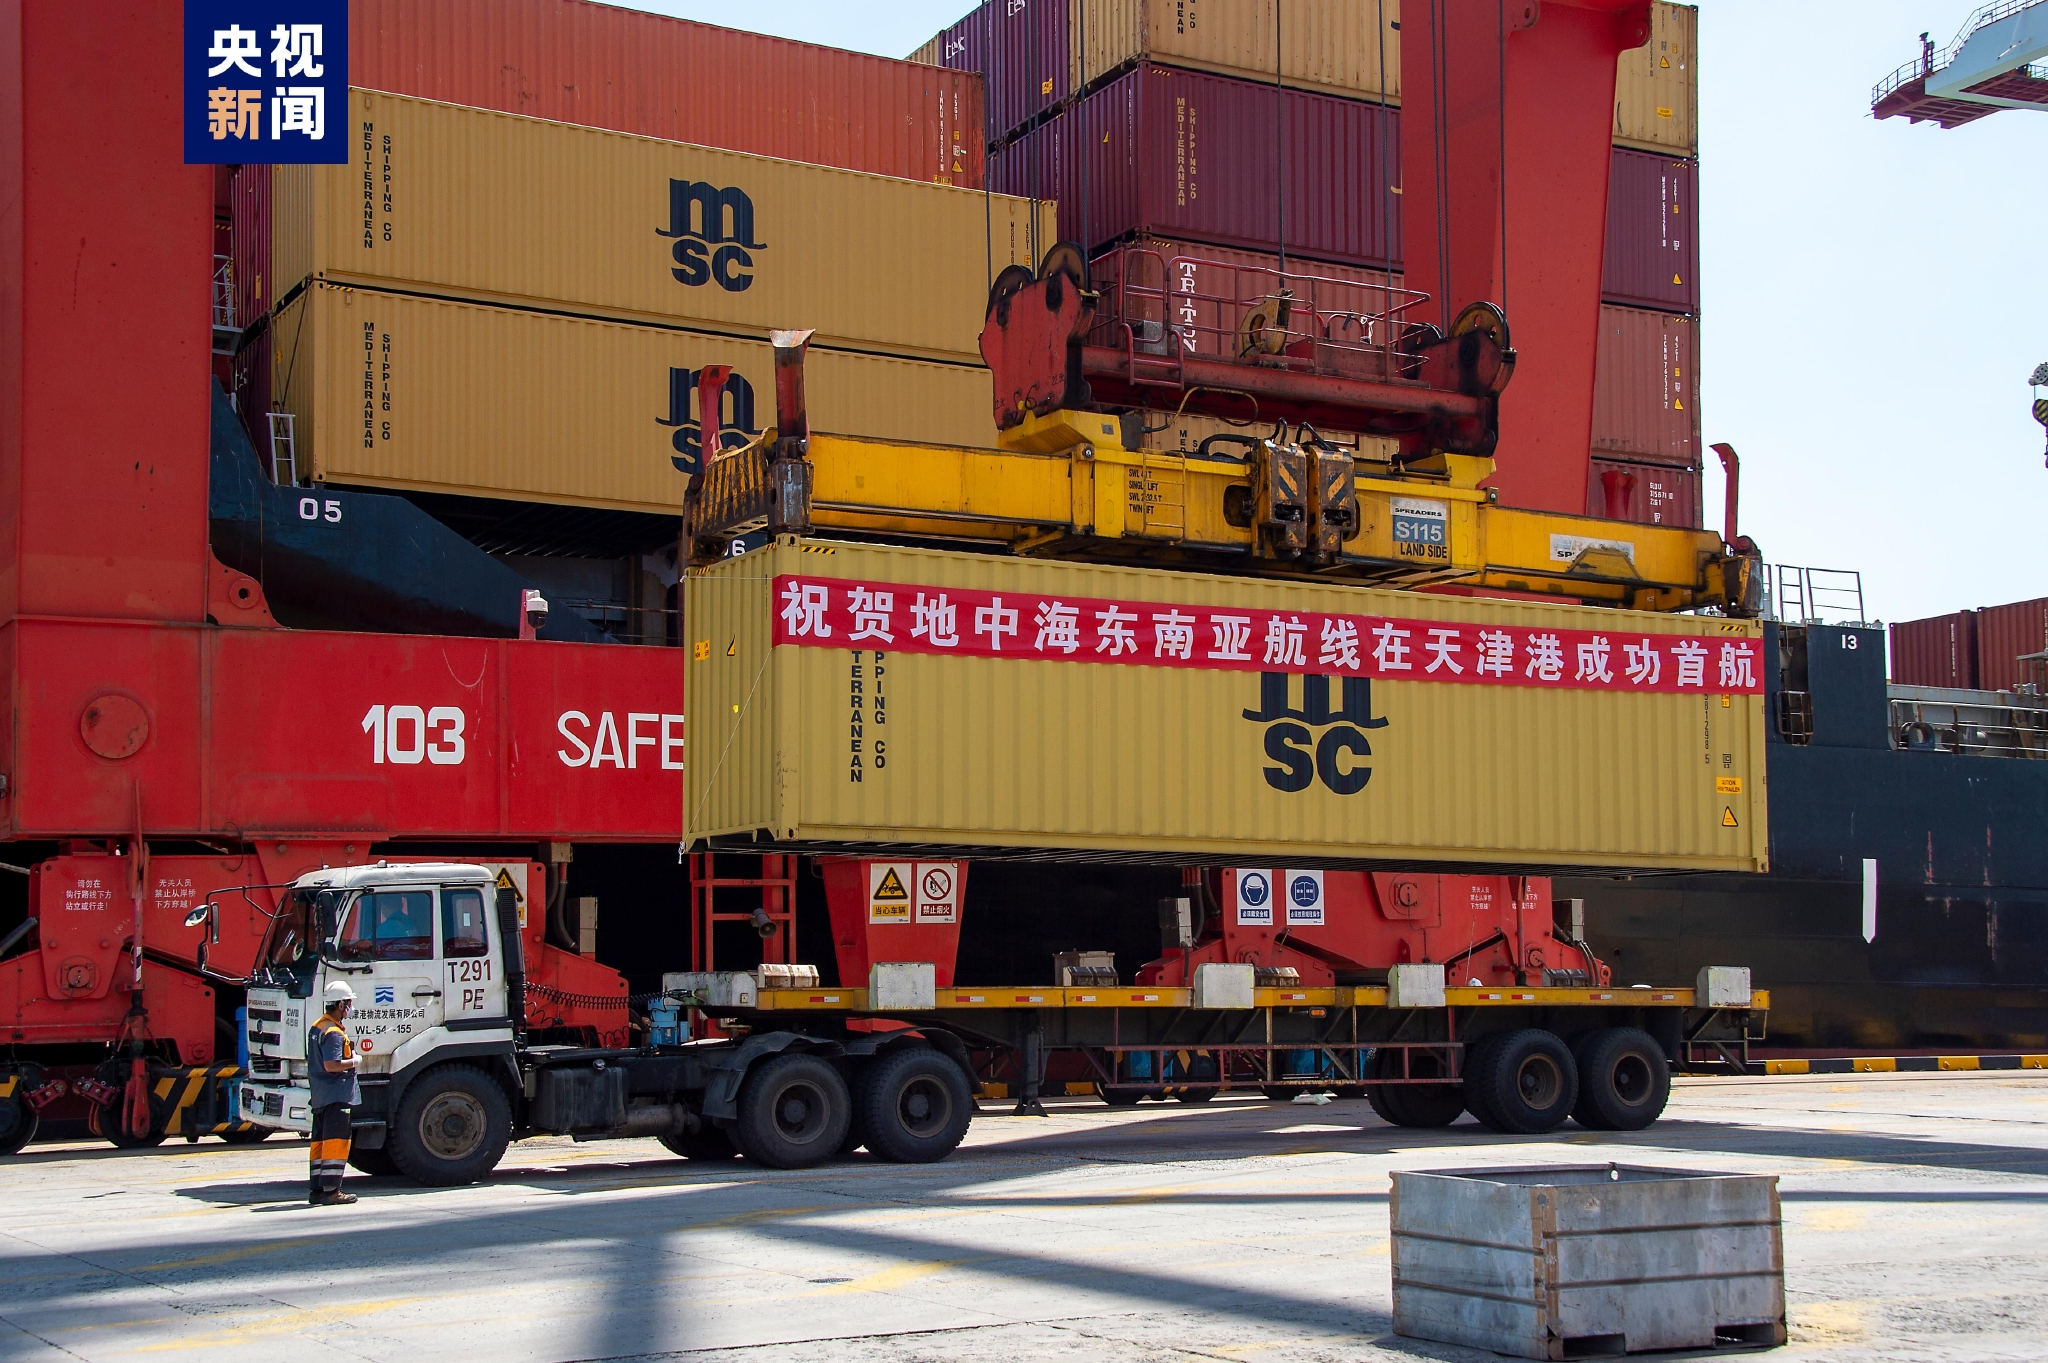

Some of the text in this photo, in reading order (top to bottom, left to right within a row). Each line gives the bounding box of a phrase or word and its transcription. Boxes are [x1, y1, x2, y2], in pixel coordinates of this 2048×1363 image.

[1177, 97, 1186, 206] MEDITERRANEAN
[1189, 108, 1197, 200] SHIPPING CO
[363, 122, 373, 249] MEDITERRANEAN
[383, 135, 392, 242] SHIPPING CO
[364, 322, 374, 449] MEDITERRANEAN
[382, 333, 391, 440] SHIPPING CO
[1129, 469, 1139, 477] SWL
[1129, 480, 1158, 491] SINGL LIFT
[1129, 492, 1139, 501] SWL
[1129, 504, 1143, 513] TWIN
[1394, 507, 1443, 517] SPREADERS
[1396, 521, 1442, 541] S115
[1400, 542, 1447, 559] LAND SIDE
[781, 580, 1757, 689] 祝贺地中海东南亚航线在天津港成功首航
[1841, 634, 1857, 650] 13
[850, 650, 863, 783] TERRANEAN
[874, 651, 886, 769] PPING CO
[361, 704, 684, 770] 103 SAFE
[77, 879, 101, 888] 请勿在
[159, 878, 192, 887] 无关人员
[65, 890, 112, 899] 钩行路线下方
[154, 889, 197, 898] 禁止从岸桥
[65, 901, 108, 911] 站立或行走！
[155, 900, 193, 909] 下方穿越！
[875, 906, 906, 915] 当心车辆
[922, 905, 950, 915] 禁止烟火
[447, 959, 491, 983] T291
[462, 988, 485, 1011] PE
[362, 1041, 373, 1049] UD
